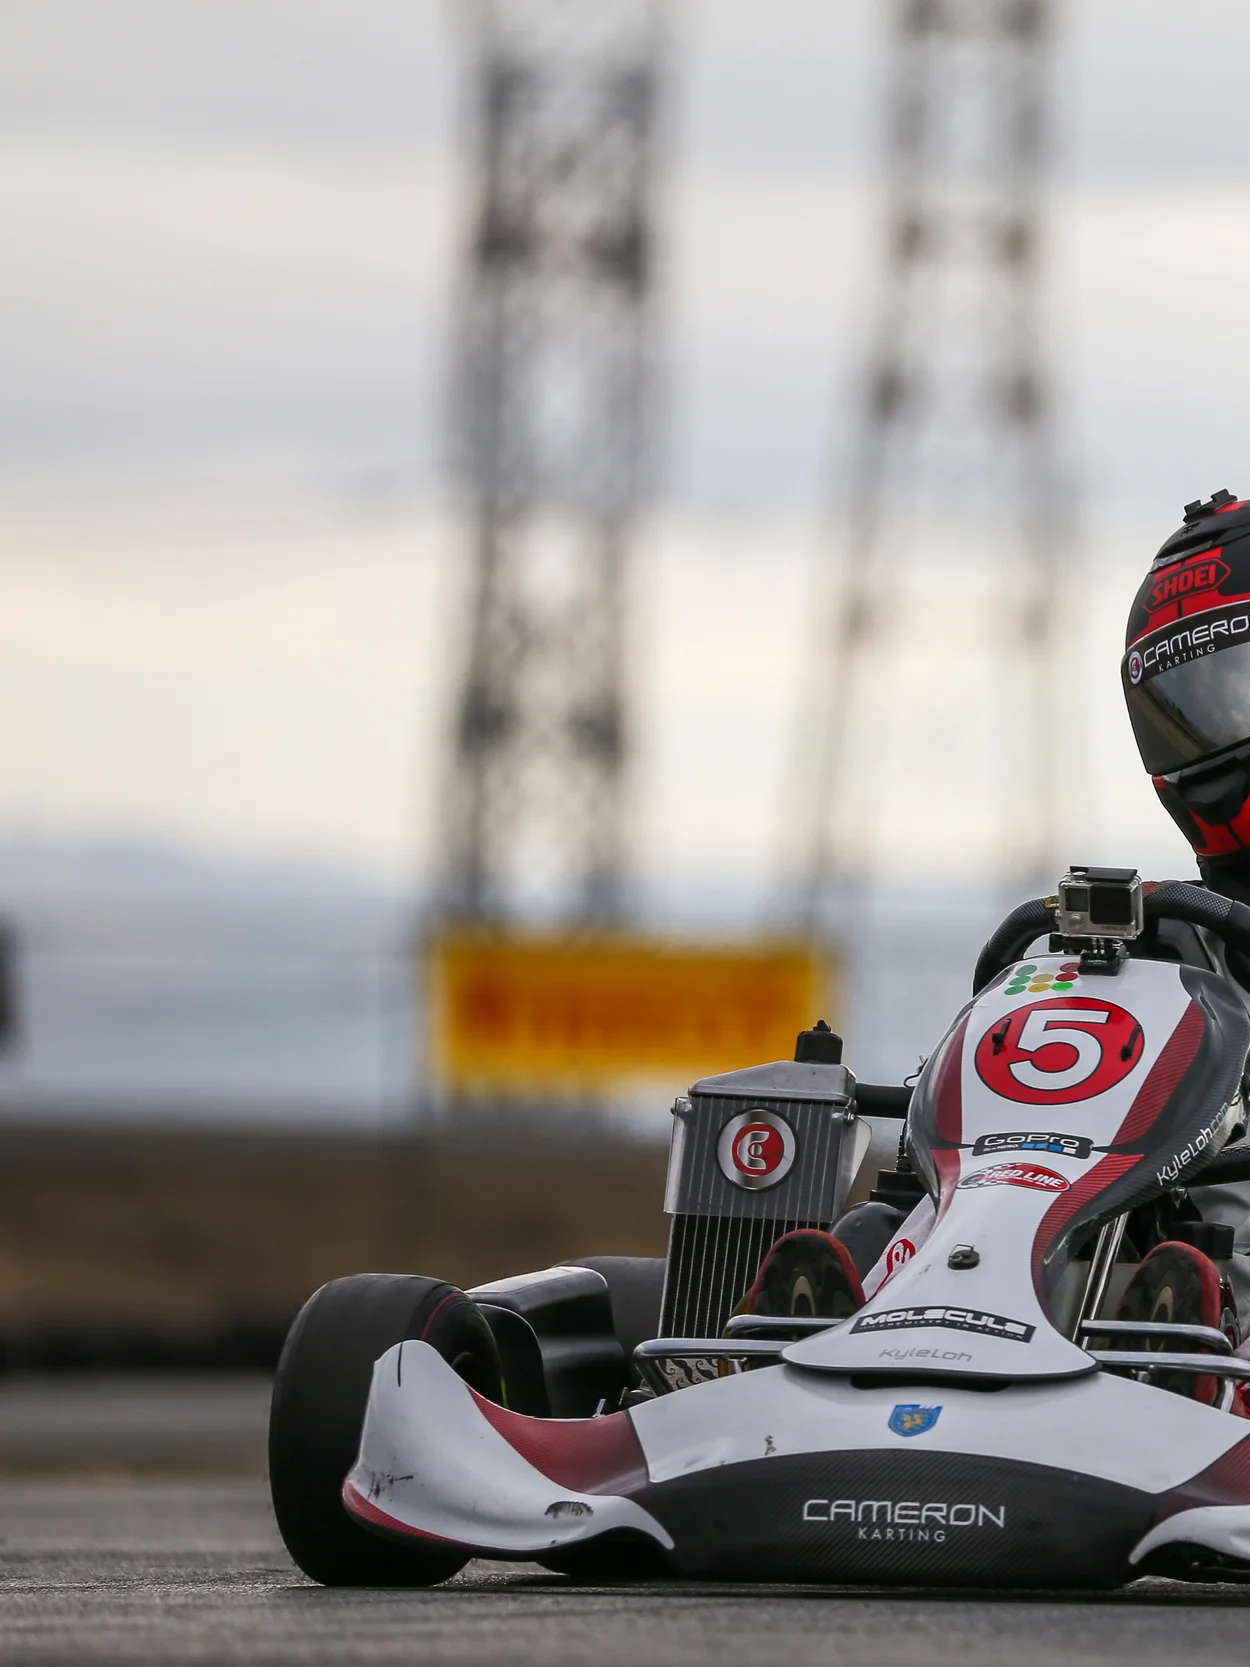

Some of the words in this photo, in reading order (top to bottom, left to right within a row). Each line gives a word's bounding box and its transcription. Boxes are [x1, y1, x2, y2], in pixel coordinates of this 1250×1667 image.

[1152, 563, 1217, 606] SHOEI
[1158, 643, 1216, 673] KARTING
[1008, 1008, 1111, 1092] 5
[984, 1134, 1080, 1148] GoPro
[1025, 1172, 1064, 1188] LINE
[860, 1308, 1028, 1335] MOLECULE
[878, 1347, 973, 1362] KyleLoh
[803, 1499, 1005, 1529] CAMERON
[858, 1527, 946, 1543] KARTING
